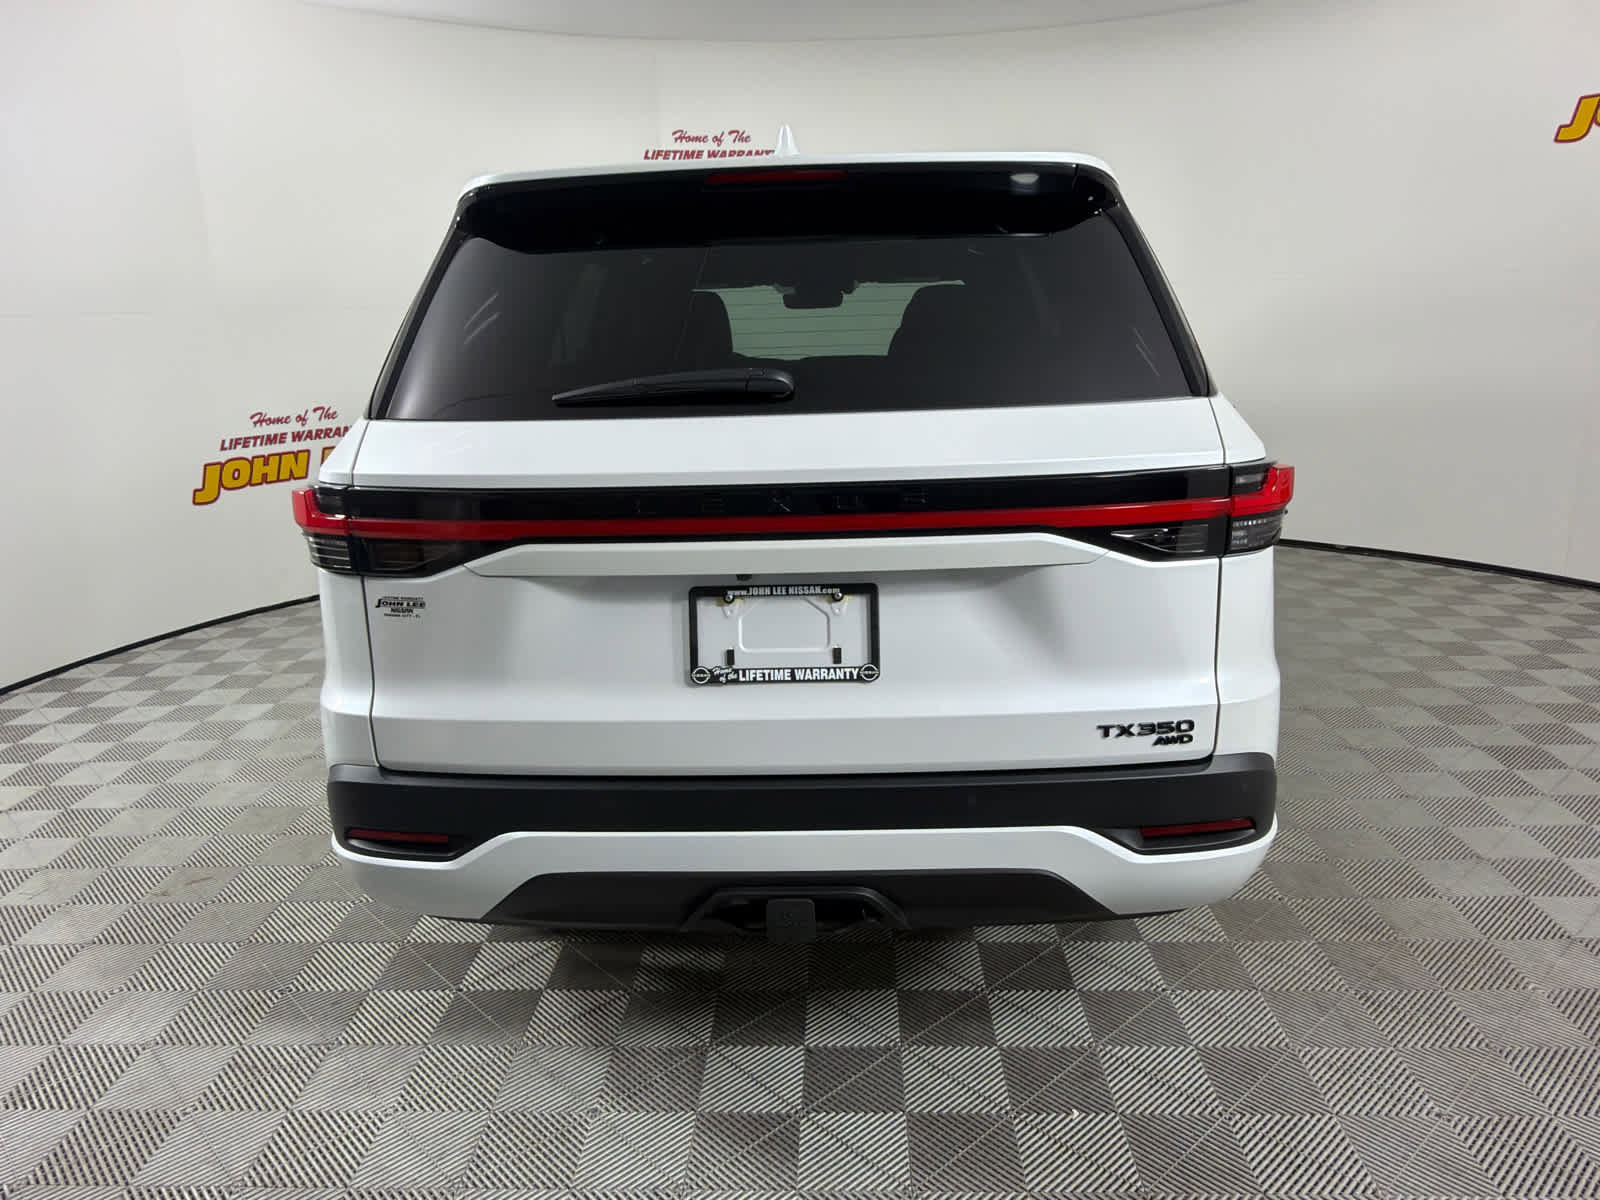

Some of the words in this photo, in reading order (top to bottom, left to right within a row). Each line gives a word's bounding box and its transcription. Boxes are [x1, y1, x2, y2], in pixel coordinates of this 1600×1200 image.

[672, 129, 708, 143] Home
[711, 131, 725, 146] of
[728, 130, 751, 143] The
[644, 149, 704, 160] LIFETIME
[250, 411, 291, 427] Home
[295, 409, 309, 426] of
[312, 406, 338, 421] The
[220, 432, 288, 451] LIFETIME
[192, 449, 311, 505] JOHN
[773, 587, 787, 595] LEE
[788, 585, 840, 595] NISSAN.com
[739, 669, 794, 681] LIFETIME
[795, 668, 859, 681] WARRANTY
[1096, 719, 1195, 738] TX350
[1152, 734, 1194, 746] AWD
